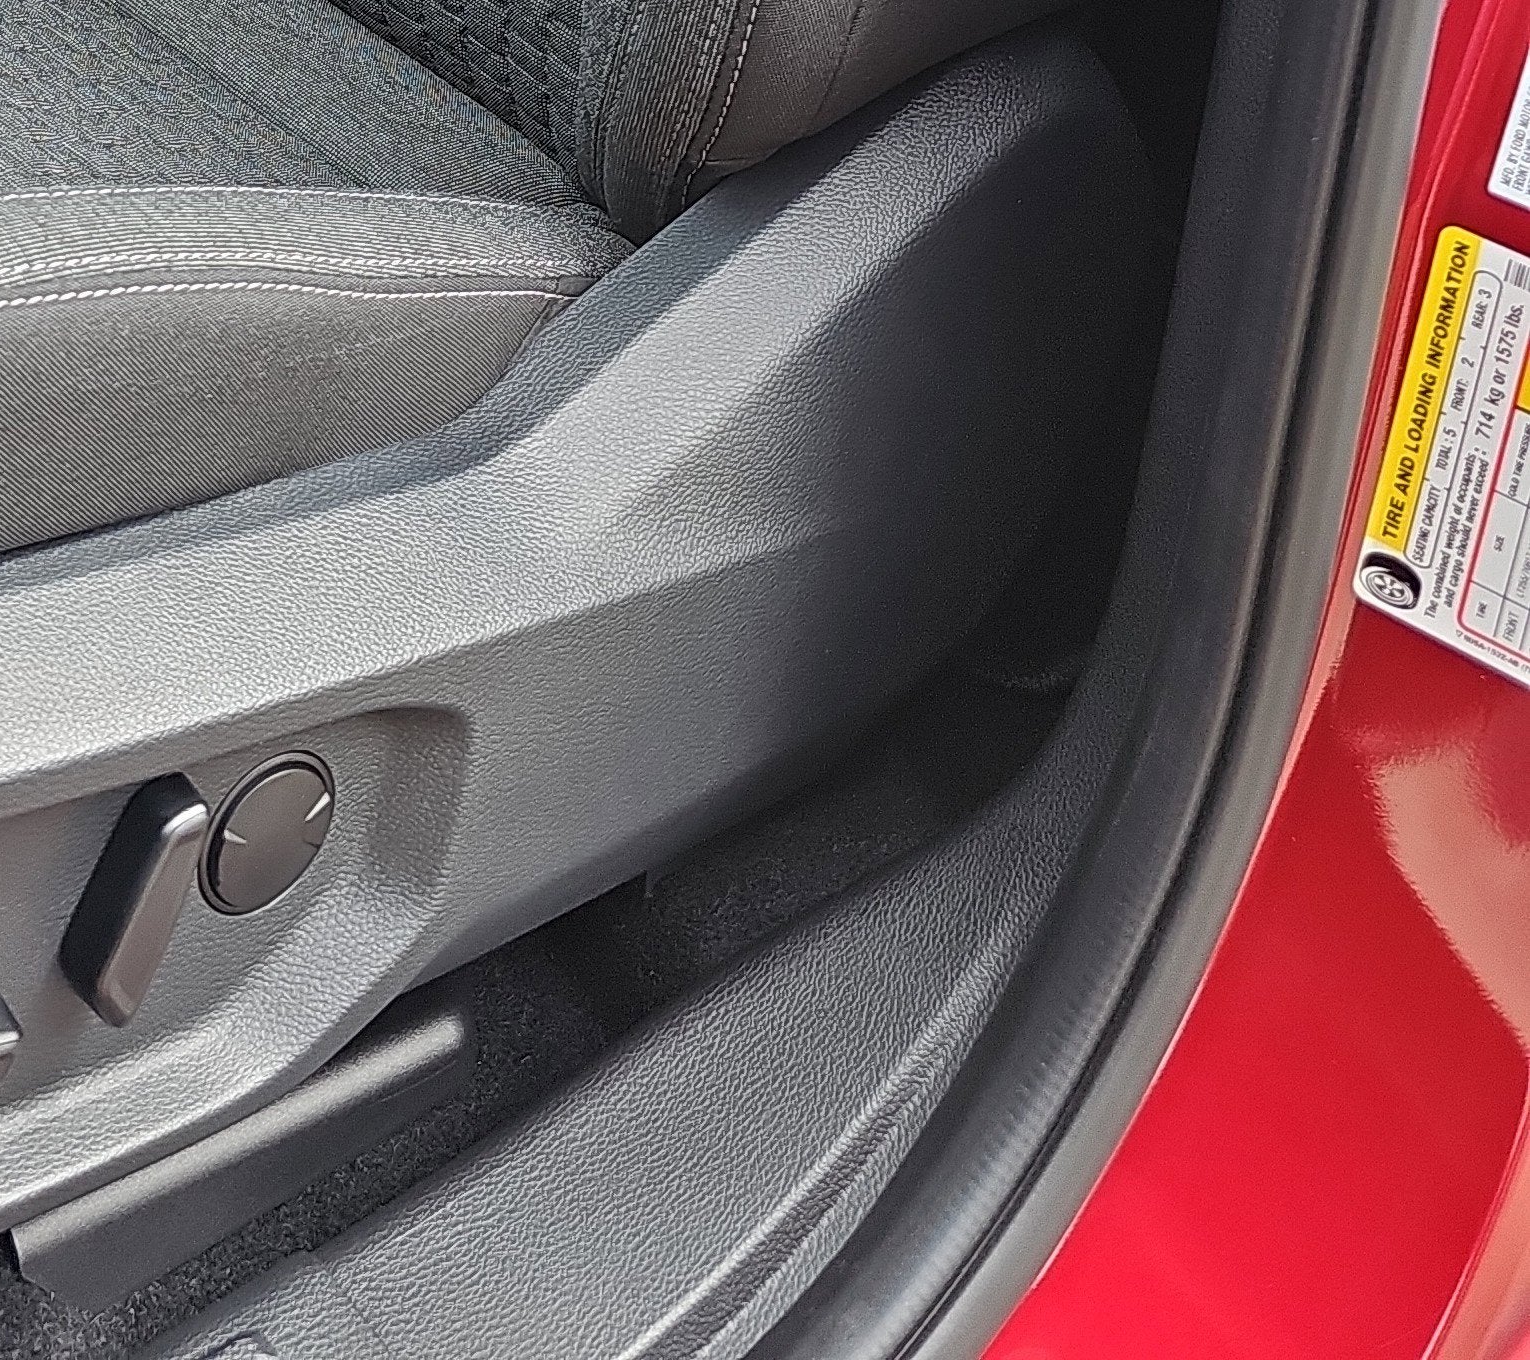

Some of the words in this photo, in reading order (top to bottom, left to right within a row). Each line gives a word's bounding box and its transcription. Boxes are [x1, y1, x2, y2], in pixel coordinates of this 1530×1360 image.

[1510, 128, 1527, 153] FORD
[1425, 240, 1470, 370] INFORMATION
[1477, 288, 1493, 299] 3
[1503, 304, 1525, 329] lbs.
[1493, 327, 1517, 365] 1575
[1460, 356, 1475, 369] 2
[1492, 367, 1507, 386] or
[1483, 387, 1506, 407] kg
[1403, 372, 1438, 454] LOADING
[1474, 410, 1496, 440] 714
[1442, 426, 1457, 438] 5
[1393, 456, 1415, 497] AND
[1456, 452, 1477, 504] occupants
[1471, 457, 1490, 495] exceed
[1507, 476, 1520, 498] COLD
[1381, 496, 1406, 539] TIRE
[1411, 526, 1431, 563] SEATING
[1421, 484, 1441, 527] CAPACITY
[1451, 502, 1464, 516] of
[1465, 494, 1480, 525] never
[1443, 515, 1461, 550] weight
[1455, 523, 1473, 559] should
[1493, 535, 1505, 552] SIZE
[1431, 549, 1452, 599] combined
[1448, 558, 1465, 588] cargo
[1423, 599, 1439, 619] The
[1443, 586, 1456, 609] and
[1502, 610, 1520, 643] FRONT
